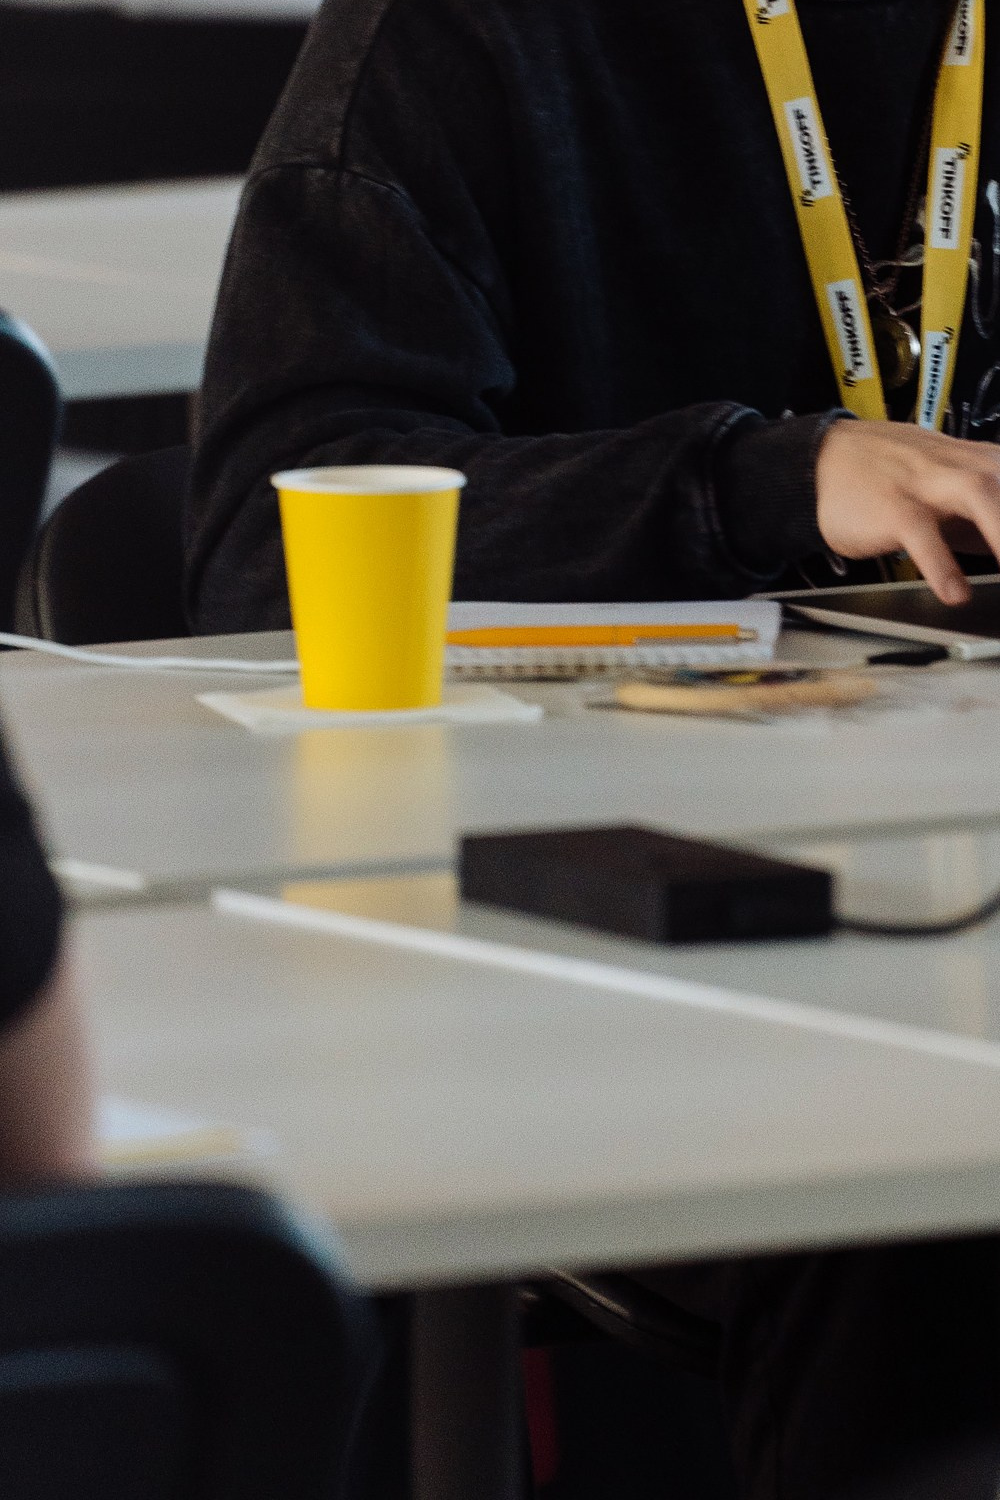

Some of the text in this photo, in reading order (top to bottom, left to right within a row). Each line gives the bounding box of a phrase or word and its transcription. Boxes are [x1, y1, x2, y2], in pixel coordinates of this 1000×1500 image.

[793, 108, 822, 190] TINKOFF
[940, 158, 957, 240] TINKOFF
[836, 290, 863, 370] TINKOFF
[924, 342, 942, 424] TINKOFF
